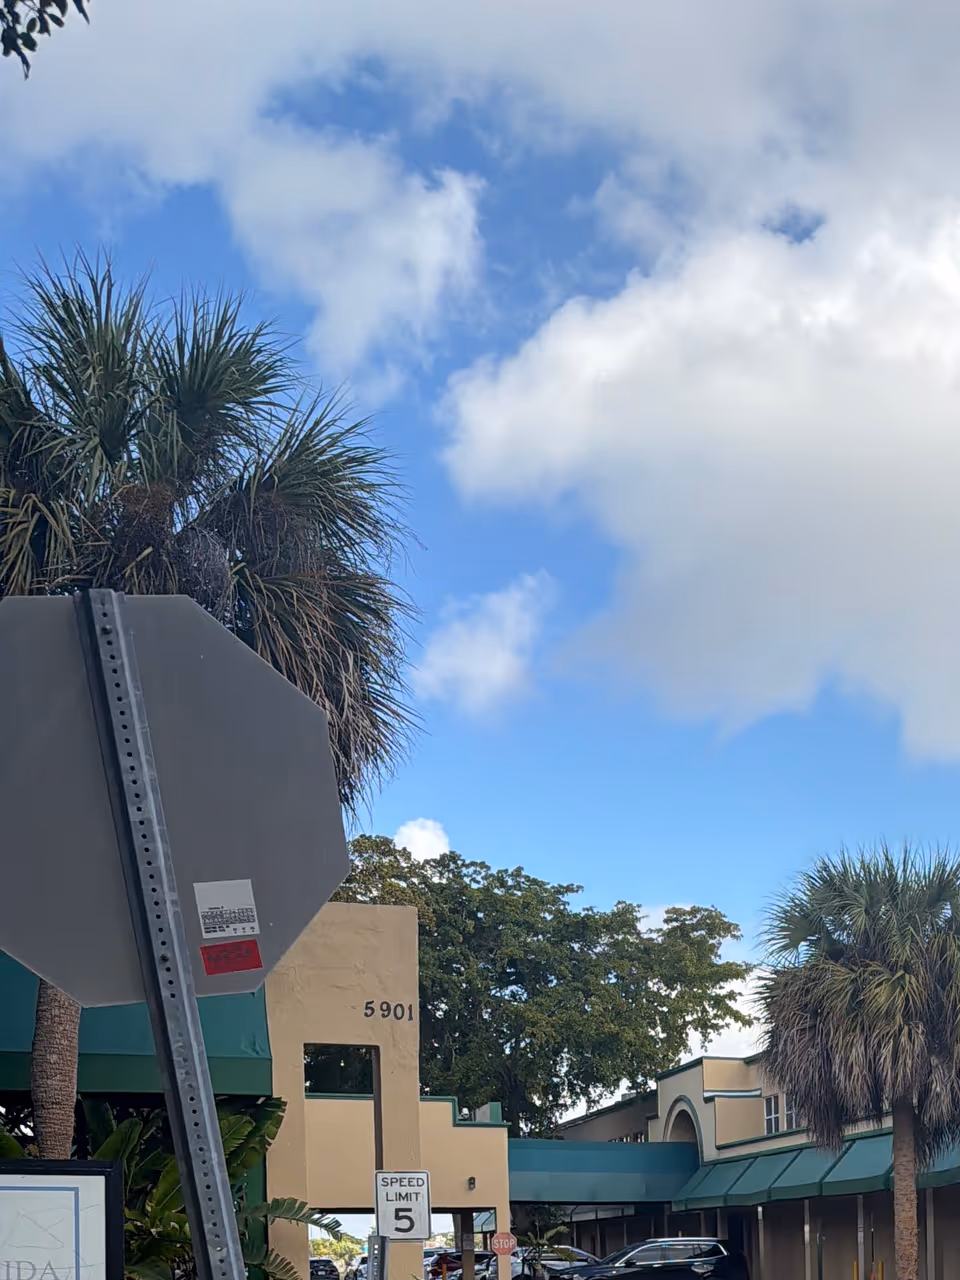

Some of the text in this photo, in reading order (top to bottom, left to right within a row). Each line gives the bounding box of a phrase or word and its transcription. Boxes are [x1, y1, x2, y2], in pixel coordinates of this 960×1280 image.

[364, 1000, 413, 1021] 5901
[381, 1177, 425, 1187] SPEED
[386, 1192, 421, 1202] LIMIT
[394, 1208, 415, 1233] 5
[493, 1239, 515, 1249] STOP
[0, 1260, 61, 1280] IDA
